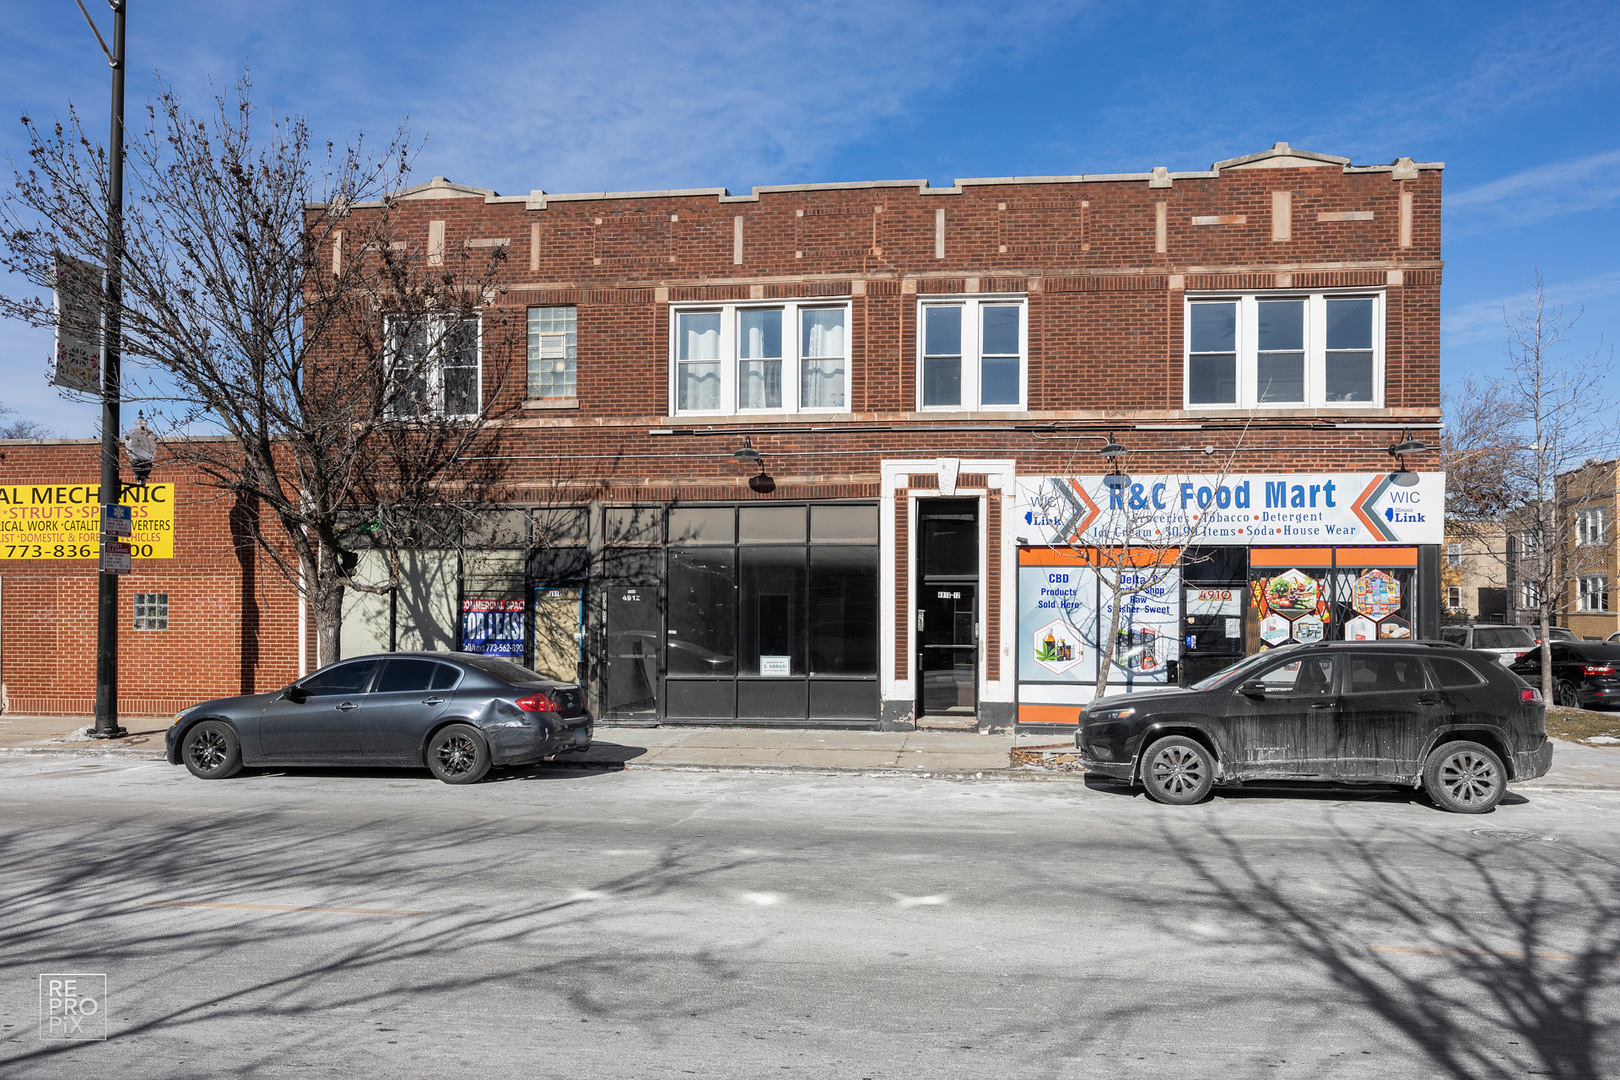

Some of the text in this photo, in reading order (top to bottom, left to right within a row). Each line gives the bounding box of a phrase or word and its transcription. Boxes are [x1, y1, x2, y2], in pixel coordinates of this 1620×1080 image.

[32, 486, 166, 504] MECHNIC
[1110, 479, 1336, 510] R&C Food Mart
[1390, 491, 1420, 503] WIC
[9, 506, 73, 519] STRUTS
[1203, 511, 1250, 523] Tobacco
[1262, 511, 1323, 523] Detergent
[1394, 512, 1425, 522] Link
[28, 520, 59, 531] WORK
[1246, 525, 1275, 536] Soda
[1283, 524, 1320, 535] House
[1325, 524, 1356, 535] Wear
[20, 533, 65, 543] DOMESTIC
[5, 544, 153, 558] 773-836-00
[1049, 573, 1069, 584] CBD
[1120, 574, 1146, 584] Delta
[1040, 588, 1077, 596] Products
[1200, 589, 1232, 600] 4910
[622, 594, 641, 602] 4912
[1129, 595, 1148, 603] Raw
[1038, 600, 1080, 609] Sold Here
[1107, 604, 1170, 614] Sisher Sweet
